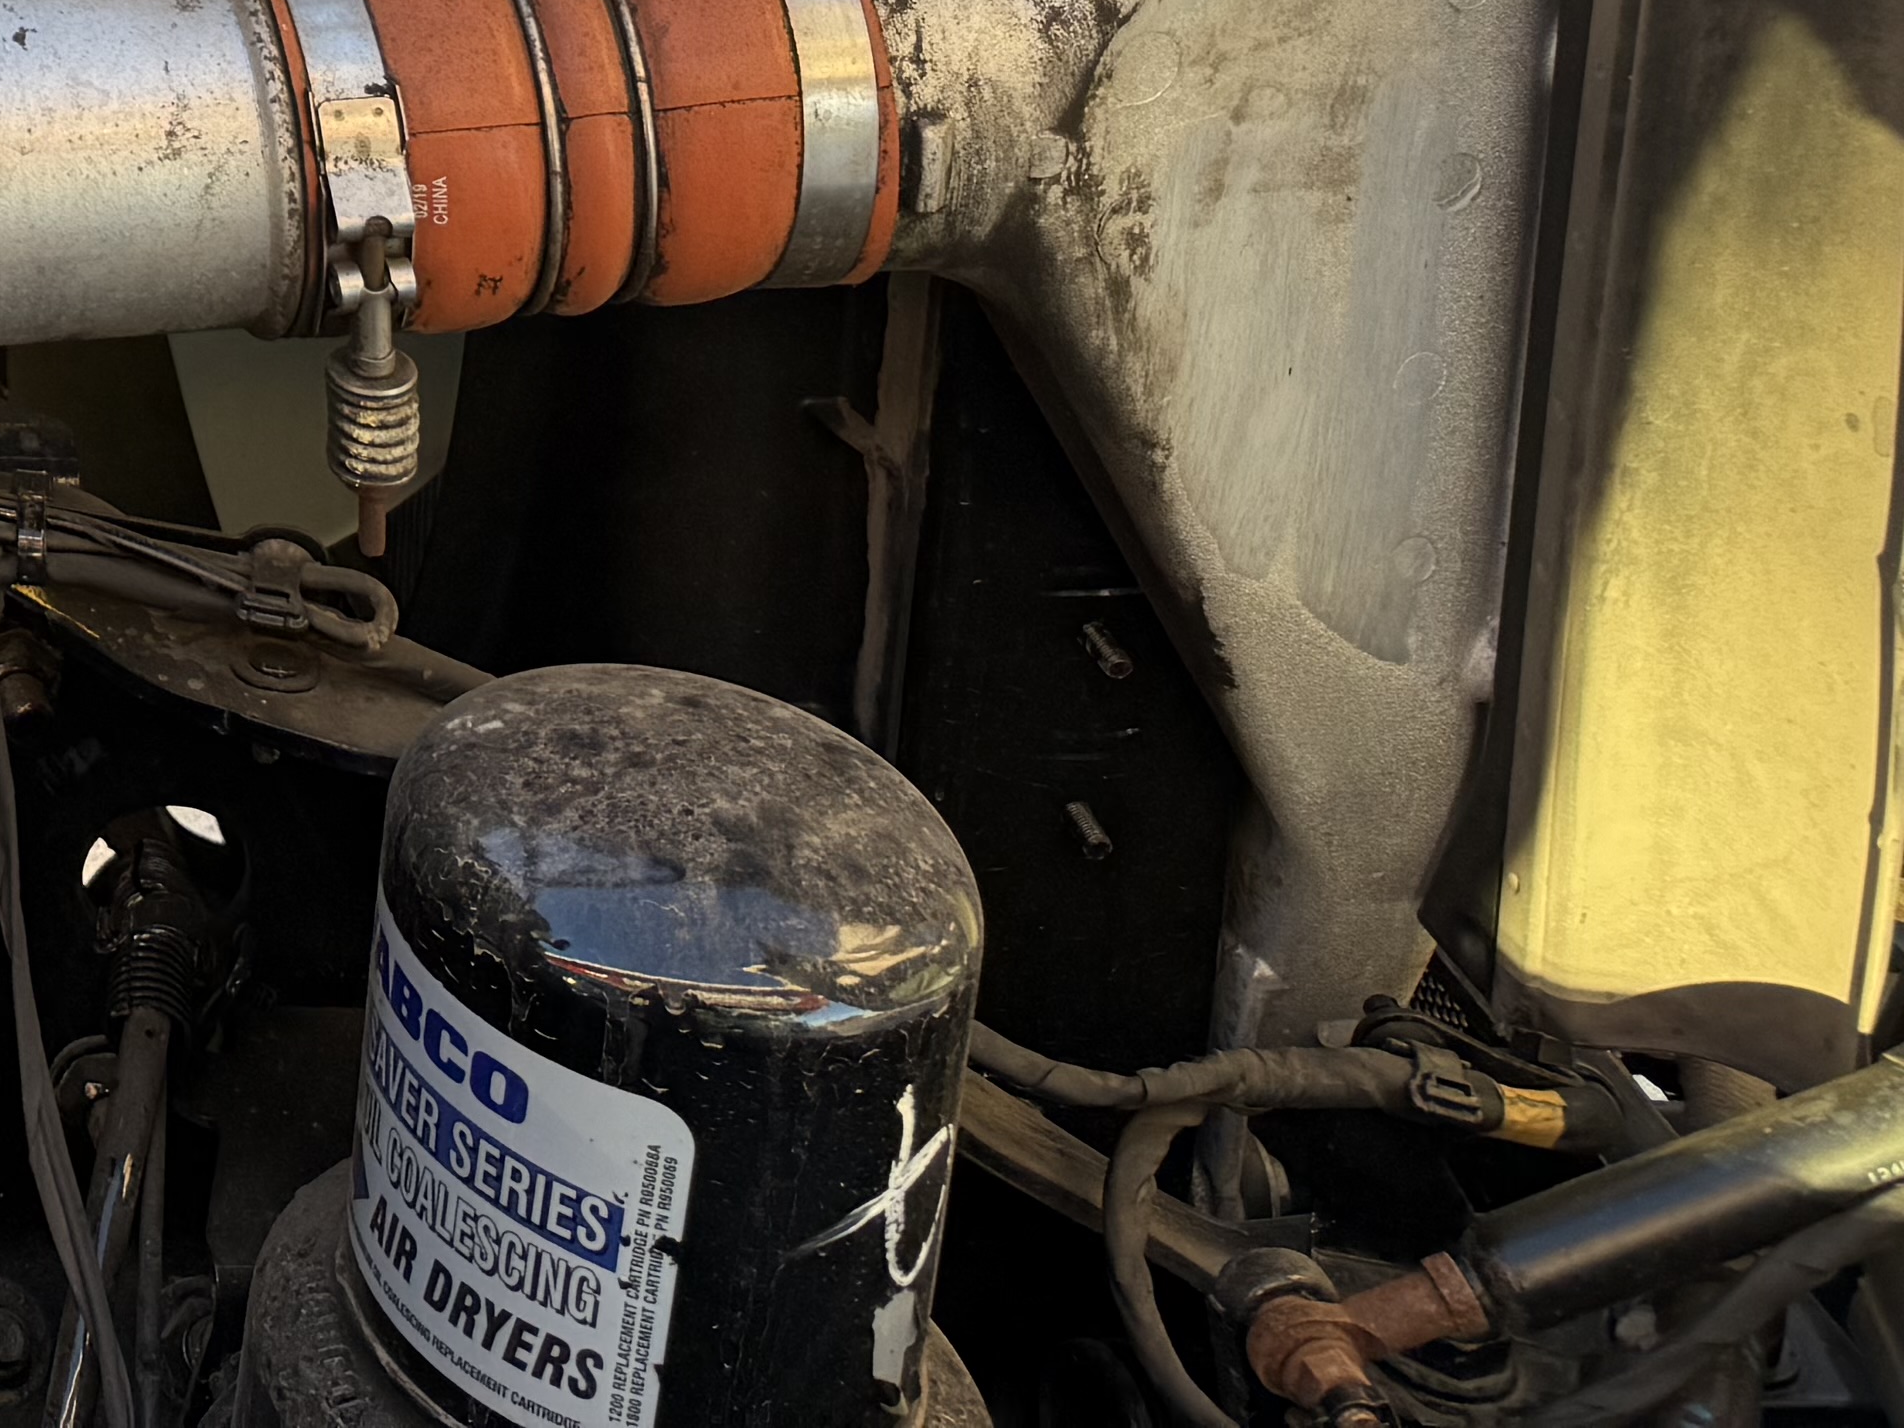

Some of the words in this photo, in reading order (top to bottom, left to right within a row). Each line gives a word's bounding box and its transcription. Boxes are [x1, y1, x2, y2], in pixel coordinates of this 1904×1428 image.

[412, 183, 428, 219] 02/19
[432, 176, 449, 225] CHINA
[374, 931, 530, 1125] ABCO
[365, 1029, 441, 1155] SAVER
[449, 1123, 611, 1258] SERIES
[637, 1210, 651, 1228] PN
[658, 1156, 679, 1212] R950069
[385, 1127, 603, 1329] COALESCING
[655, 1215, 670, 1232] PN
[368, 1194, 419, 1284] AIR
[423, 1259, 604, 1400] DRYERS
[627, 1227, 649, 1300] CARTRIDGE
[643, 1231, 665, 1304] CARTRID
[432, 1334, 508, 1399] REPLACEMENT
[614, 1301, 638, 1396] REPLACEMENT
[630, 1306, 655, 1396] REPLACEMENT
[610, 1399, 625, 1424] 1200
